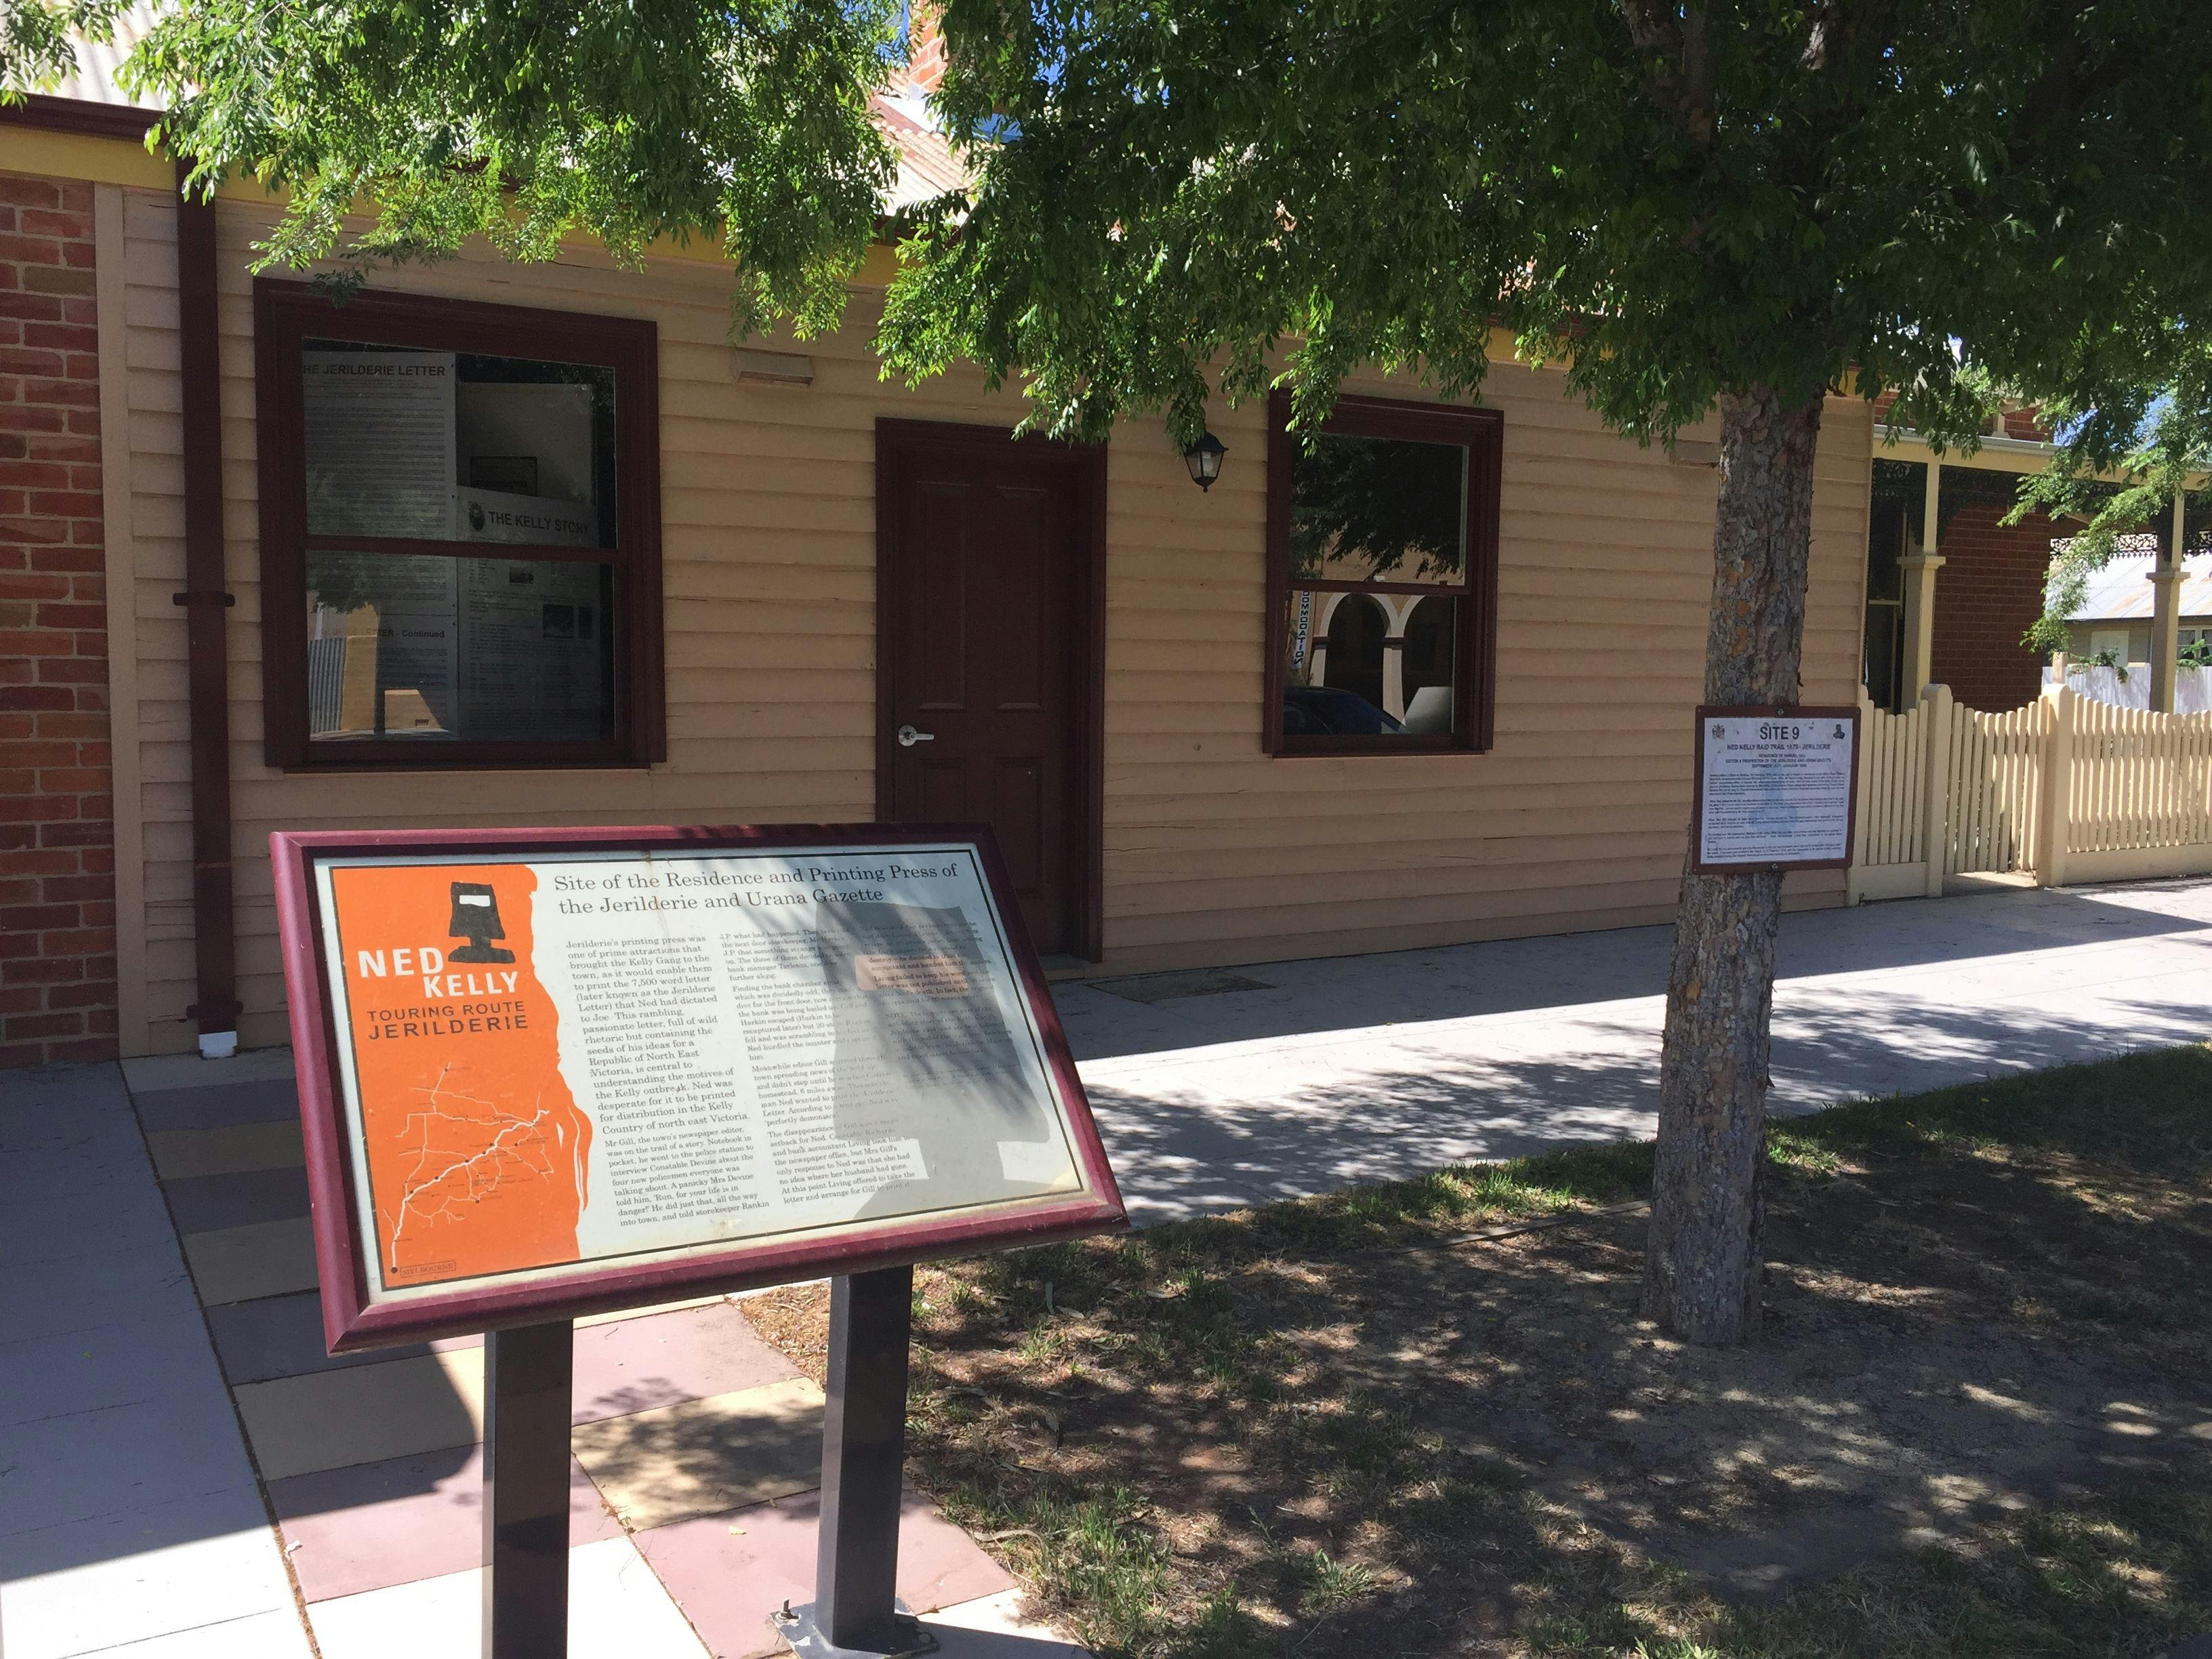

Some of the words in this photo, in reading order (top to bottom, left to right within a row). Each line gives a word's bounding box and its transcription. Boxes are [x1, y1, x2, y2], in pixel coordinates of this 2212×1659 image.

[303, 365, 319, 375] HE
[323, 365, 392, 375] JERILDERIE
[398, 365, 446, 376] LETTER
[488, 511, 512, 527] THE
[515, 514, 552, 531] KELLY
[555, 520, 592, 535] STORY
[401, 630, 445, 638] Continued
[1760, 726, 1789, 740] SITE
[1792, 726, 1800, 740] 9
[554, 876, 596, 891] Site
[602, 874, 621, 890] of
[627, 873, 660, 888] the
[665, 871, 763, 887] Residence
[769, 867, 805, 884] and
[808, 866, 886, 882] Printing
[888, 865, 938, 879] Press
[942, 863, 958, 877] of
[558, 899, 594, 914] the
[600, 895, 698, 913] Jerilderie
[704, 892, 742, 908] and
[745, 891, 808, 907] Urana
[812, 888, 884, 907] Gazette
[567, 939, 619, 949] Jerilderie's
[621, 937, 659, 947] printing
[662, 937, 687, 945] press
[588, 949, 597, 958] of
[600, 949, 628, 959] prime
[630, 947, 680, 956] attractions
[682, 945, 701, 953] that
[358, 947, 443, 978] NED
[570, 960, 609, 970] brought
[611, 959, 626, 967] the
[629, 957, 653, 966] Kelly
[656, 956, 682, 965] Gang
[695, 954, 710, 962] the
[626, 968, 654, 977] would
[656, 966, 687, 975] enable
[689, 964, 712, 972] them
[423, 971, 518, 998] KELLY
[587, 982, 611, 992] print
[614, 979, 630, 988] the
[632, 978, 657, 987] 7,500
[660, 976, 684, 985] word
[685, 975, 711, 983] letter
[577, 993, 603, 1002] (later
[606, 991, 638, 1000] known
[653, 987, 669, 996] the
[672, 985, 716, 994] Jerilderie
[366, 1006, 455, 1022] TOURING
[462, 1000, 525, 1016] ROUTE
[578, 1002, 613, 1012] Letter)
[615, 1001, 636, 1009] that
[638, 998, 657, 1008] Ned
[660, 997, 678, 1006] had
[680, 994, 718, 1004] dictated
[615, 1011, 637, 1020] This
[368, 1015, 529, 1040] JERILDERIE
[583, 1023, 635, 1036] passionate
[668, 1017, 684, 1027] full
[687, 1017, 696, 1025] of
[697, 1015, 718, 1024] wild
[586, 1036, 623, 1044] rhetoric
[645, 1029, 696, 1040] containing
[697, 1027, 713, 1035] the
[587, 1046, 614, 1055] seeds
[617, 1044, 626, 1052] of
[628, 1044, 643, 1052] his
[645, 1042, 671, 1050] ideas
[673, 1040, 687, 1048] for
[589, 1055, 632, 1067] Republic
[635, 1053, 644, 1062] of
[647, 1050, 676, 1061] North
[678, 1049, 700, 1059] East
[647, 1061, 681, 1072] central
[594, 1075, 666, 1088] understanding
[668, 1072, 684, 1081] the
[687, 1070, 723, 1080] motives
[725, 1067, 735, 1076] of
[596, 1090, 612, 1100] the
[615, 1088, 640, 1098] Kelly
[692, 1080, 712, 1090] Ned
[598, 1100, 647, 1111] desperate
[649, 1097, 662, 1106] for
[687, 1093, 699, 1101] be
[701, 1089, 736, 1102] printed
[600, 1113, 614, 1122] for
[617, 1107, 676, 1120] distribution
[690, 1103, 706, 1113] the
[708, 1101, 733, 1111] Kelly
[602, 1124, 644, 1134] Country
[647, 1121, 656, 1130] of
[659, 1118, 686, 1129] north
[688, 1117, 708, 1126] east
[638, 1136, 651, 1144] the
[653, 1133, 677, 1142] town's
[679, 1130, 719, 1139] newspaper
[789, 1155, 827, 1164] newspaper
[880, 1145, 898, 1153] Gill's
[649, 1172, 688, 1183] policemen
[690, 1168, 724, 1177] everyone
[807, 1173, 829, 1181] where
[844, 1166, 875, 1176] husband
[876, 1164, 890, 1172] had
[403, 1263, 454, 1275] MELBOURNE
